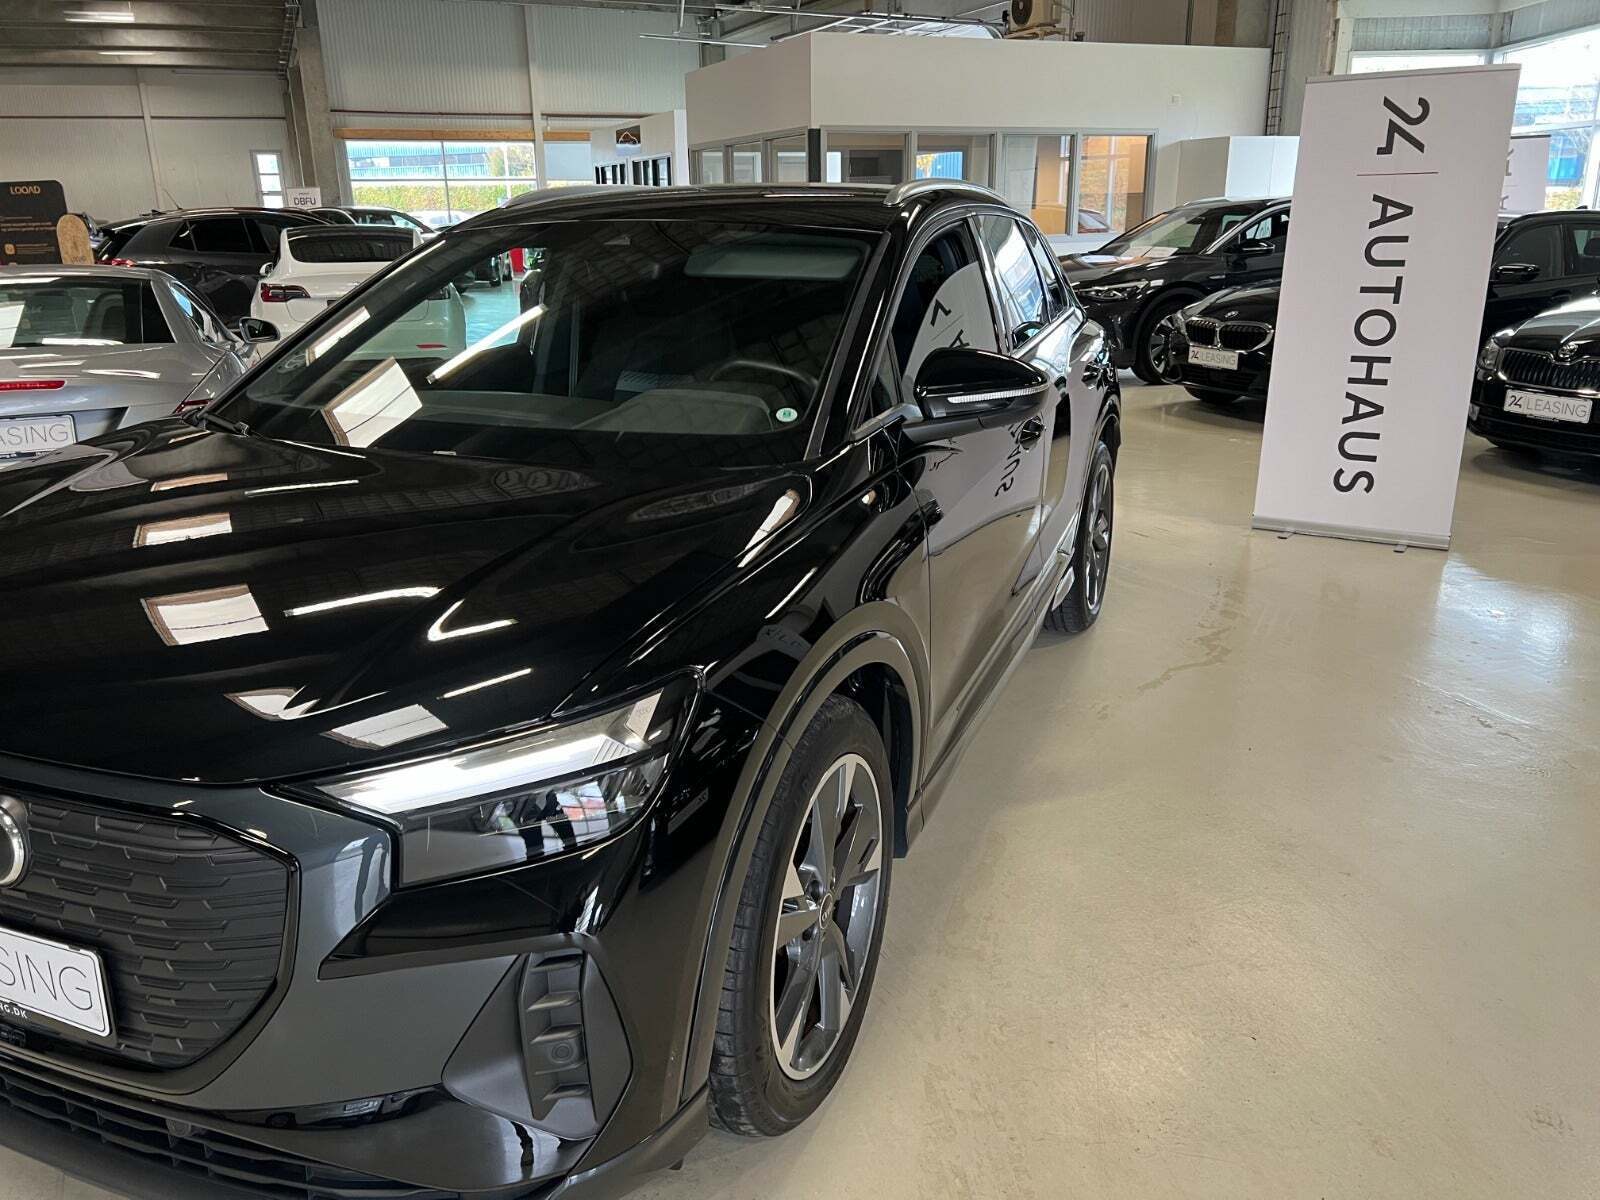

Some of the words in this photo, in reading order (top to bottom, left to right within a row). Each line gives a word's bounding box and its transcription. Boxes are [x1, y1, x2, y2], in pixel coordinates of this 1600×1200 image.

[1376, 95, 1431, 156] 24
[1202, 351, 1236, 366] LEASING
[1333, 193, 1414, 494] AUTOHAUS
[1508, 394, 1523, 409] 24
[1526, 398, 1588, 418] LEASING
